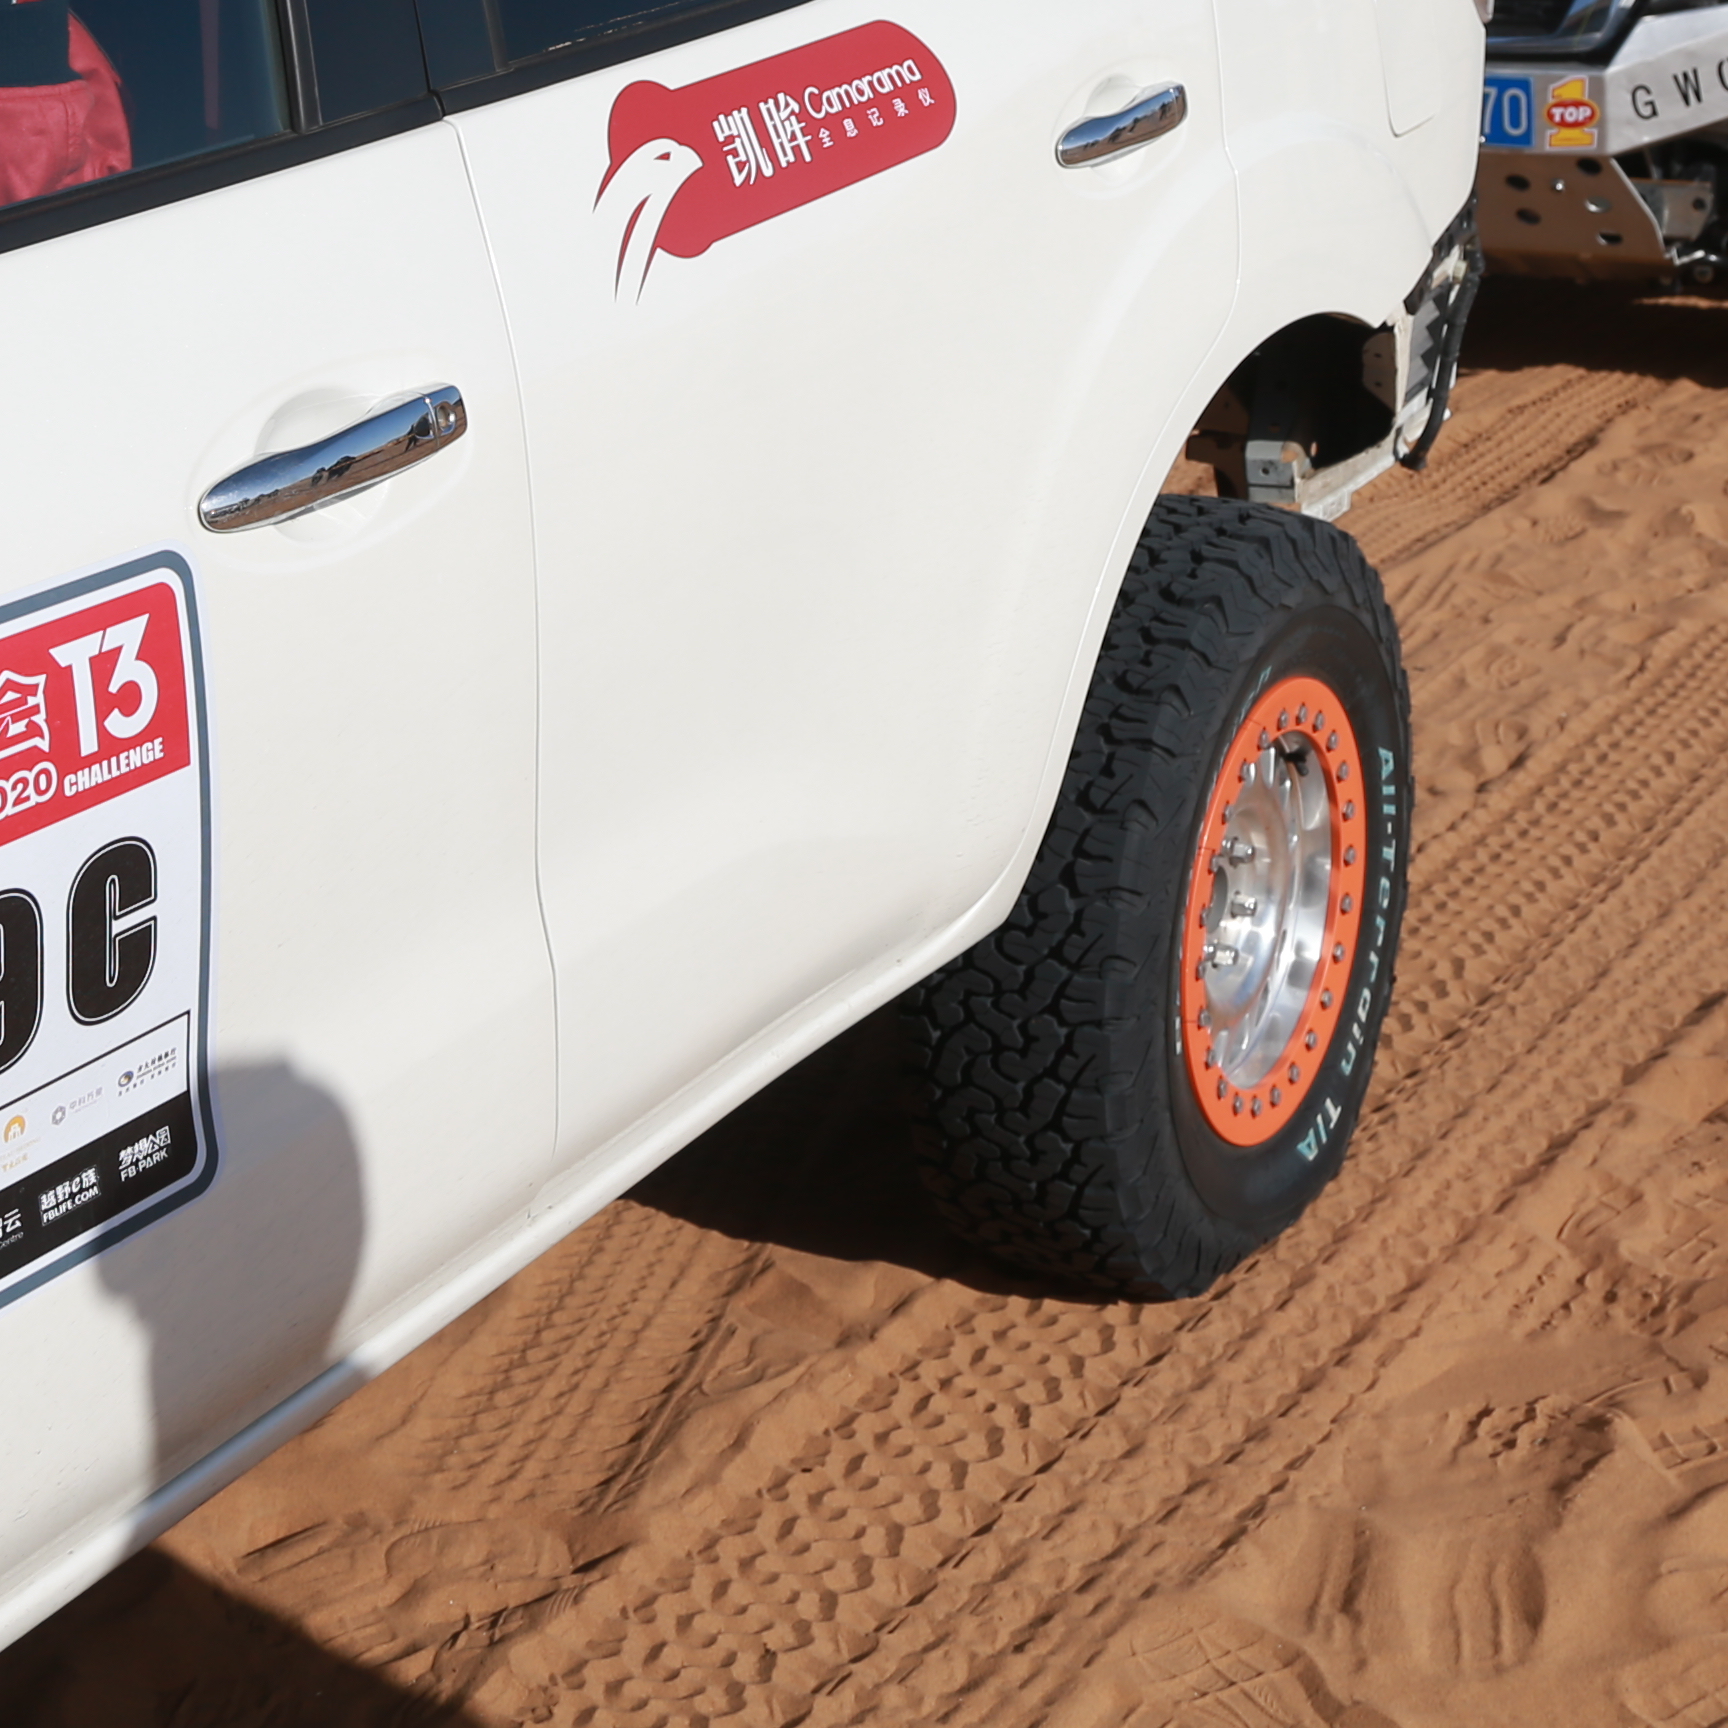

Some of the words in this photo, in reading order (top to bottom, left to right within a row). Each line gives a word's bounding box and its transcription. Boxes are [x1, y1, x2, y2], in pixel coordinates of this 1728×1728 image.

[804, 59, 922, 119] Camorama
[818, 87, 935, 148] 全息记录仪
[1551, 106, 1593, 124] TOP
[51, 613, 159, 758] T3
[63, 738, 164, 797] CHALLENGE
[40, 1166, 98, 1210] 越野e族
[42, 1185, 100, 1223] FBLIFE.COM
